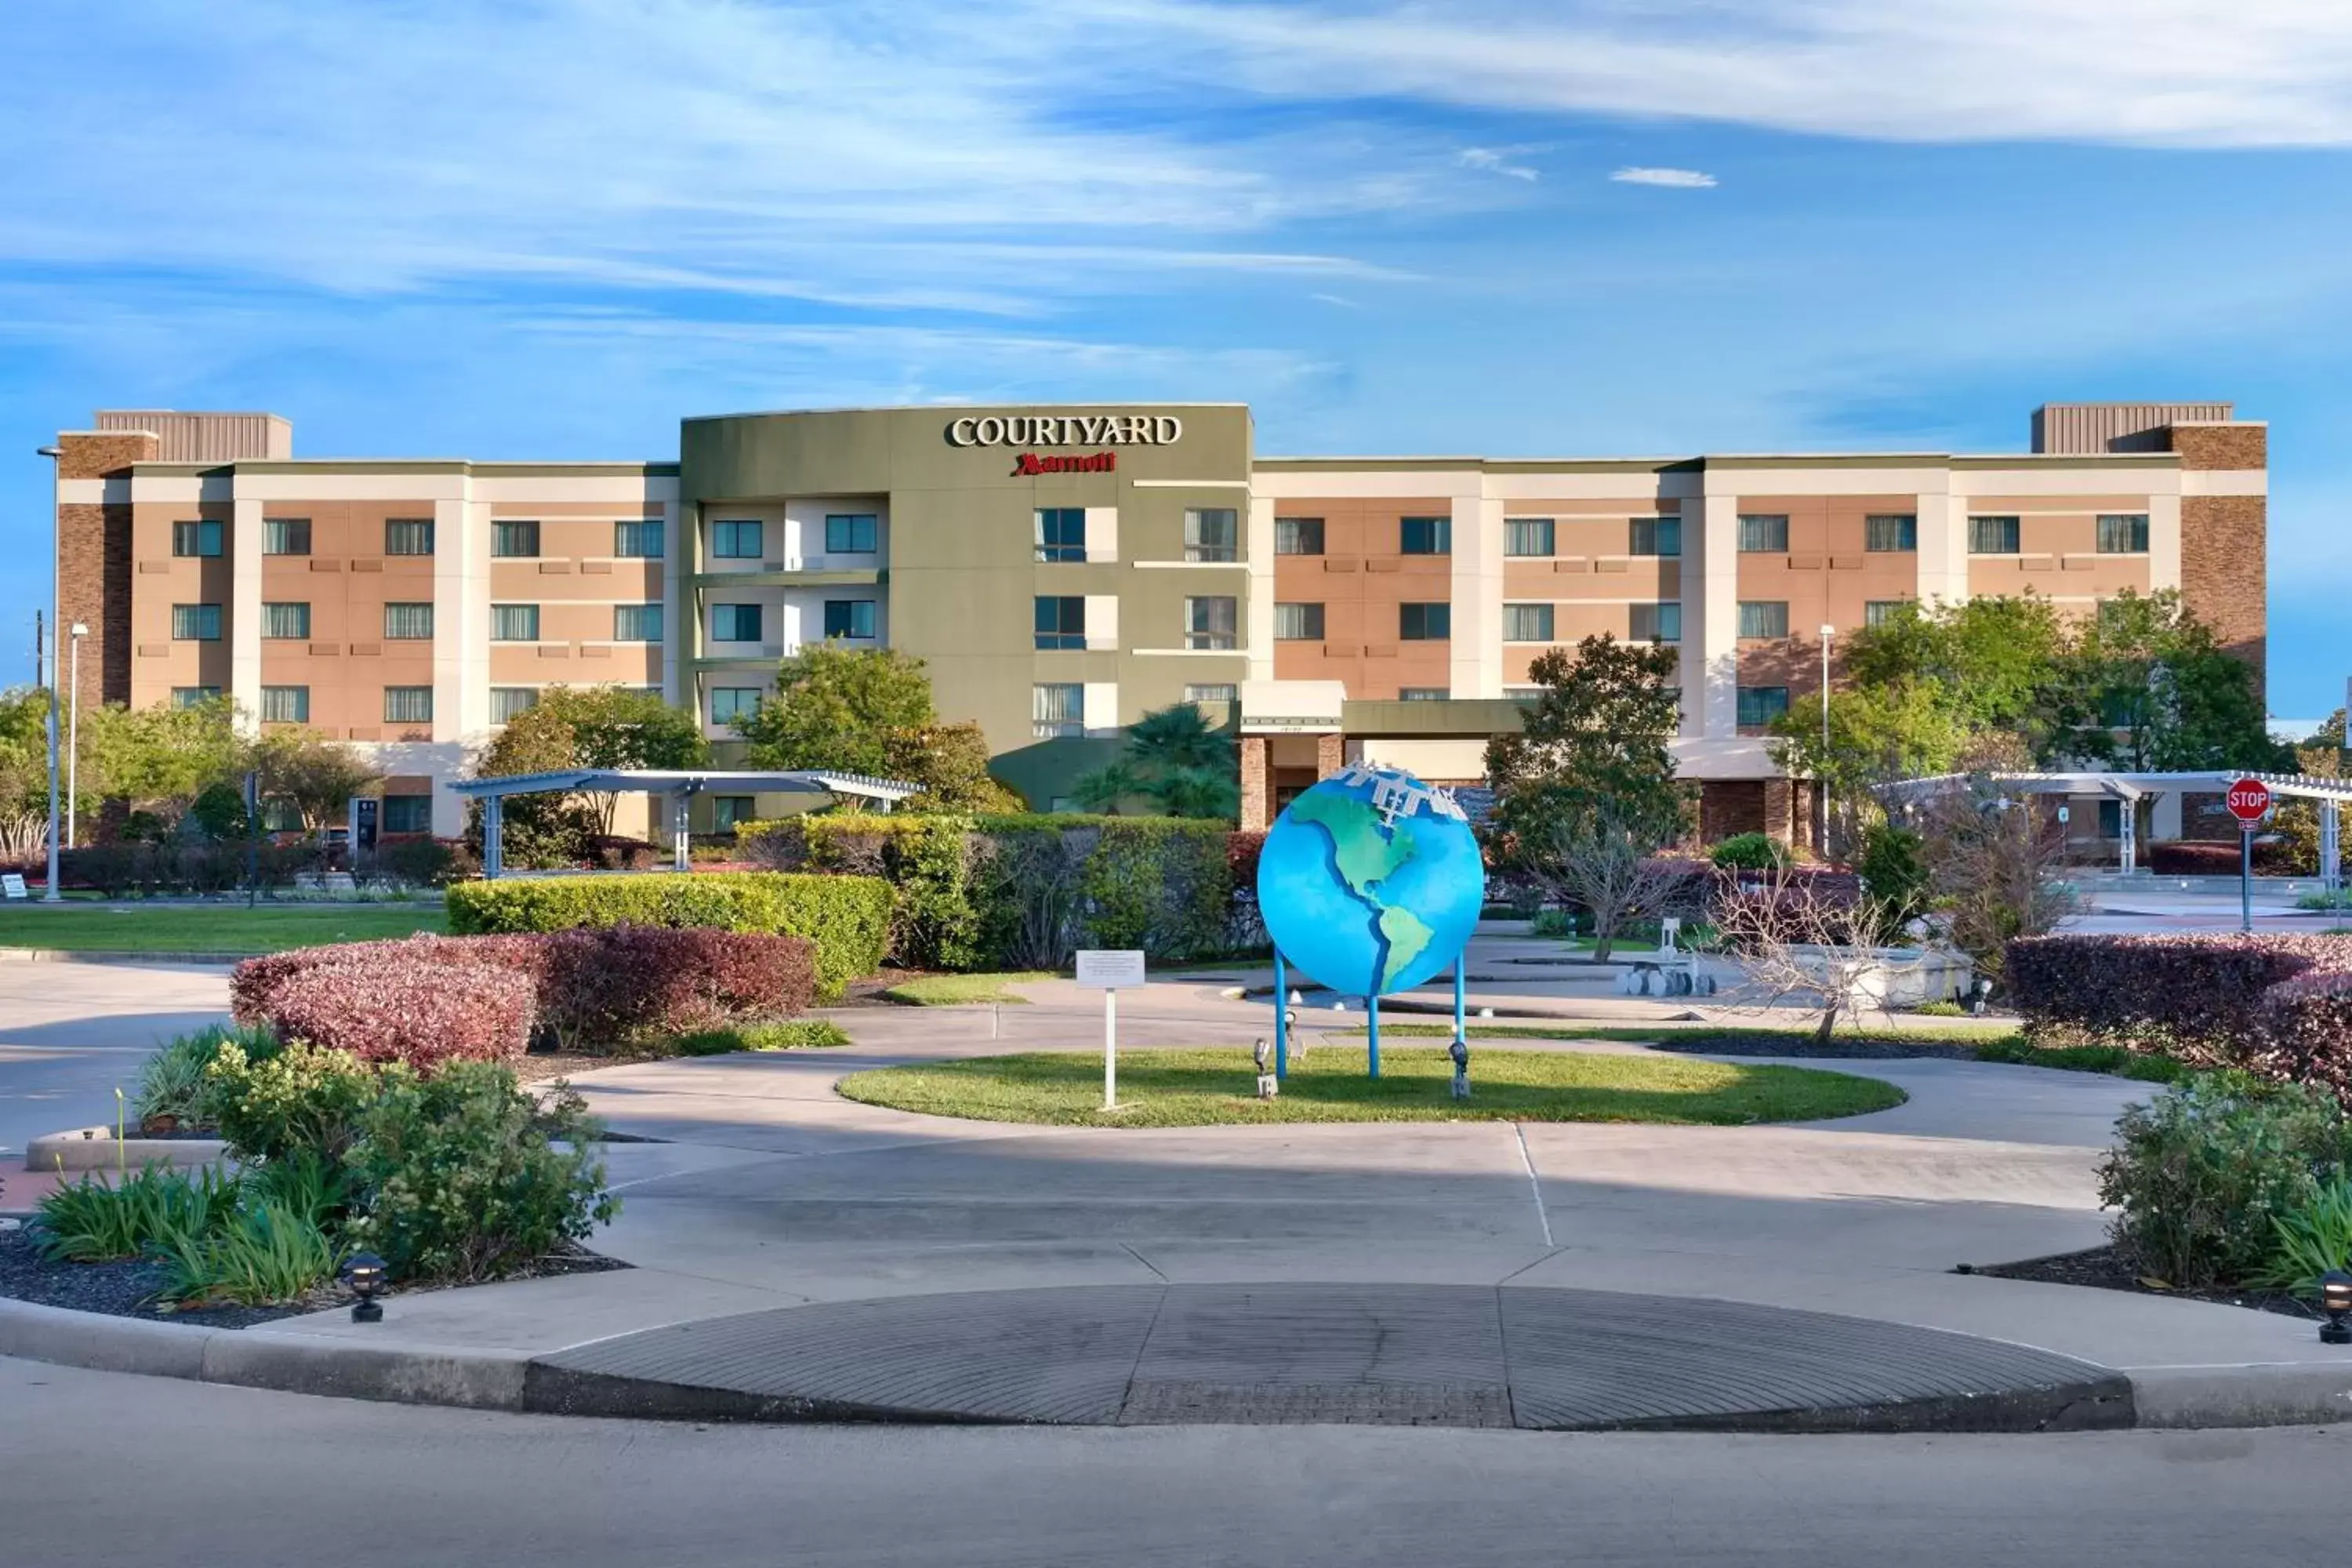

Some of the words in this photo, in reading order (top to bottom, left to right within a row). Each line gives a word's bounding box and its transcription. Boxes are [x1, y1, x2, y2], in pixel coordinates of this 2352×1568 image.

[951, 416, 1182, 445] COURTYARD
[1014, 452, 1116, 476] Marriott
[2230, 791, 2267, 807] STOP
